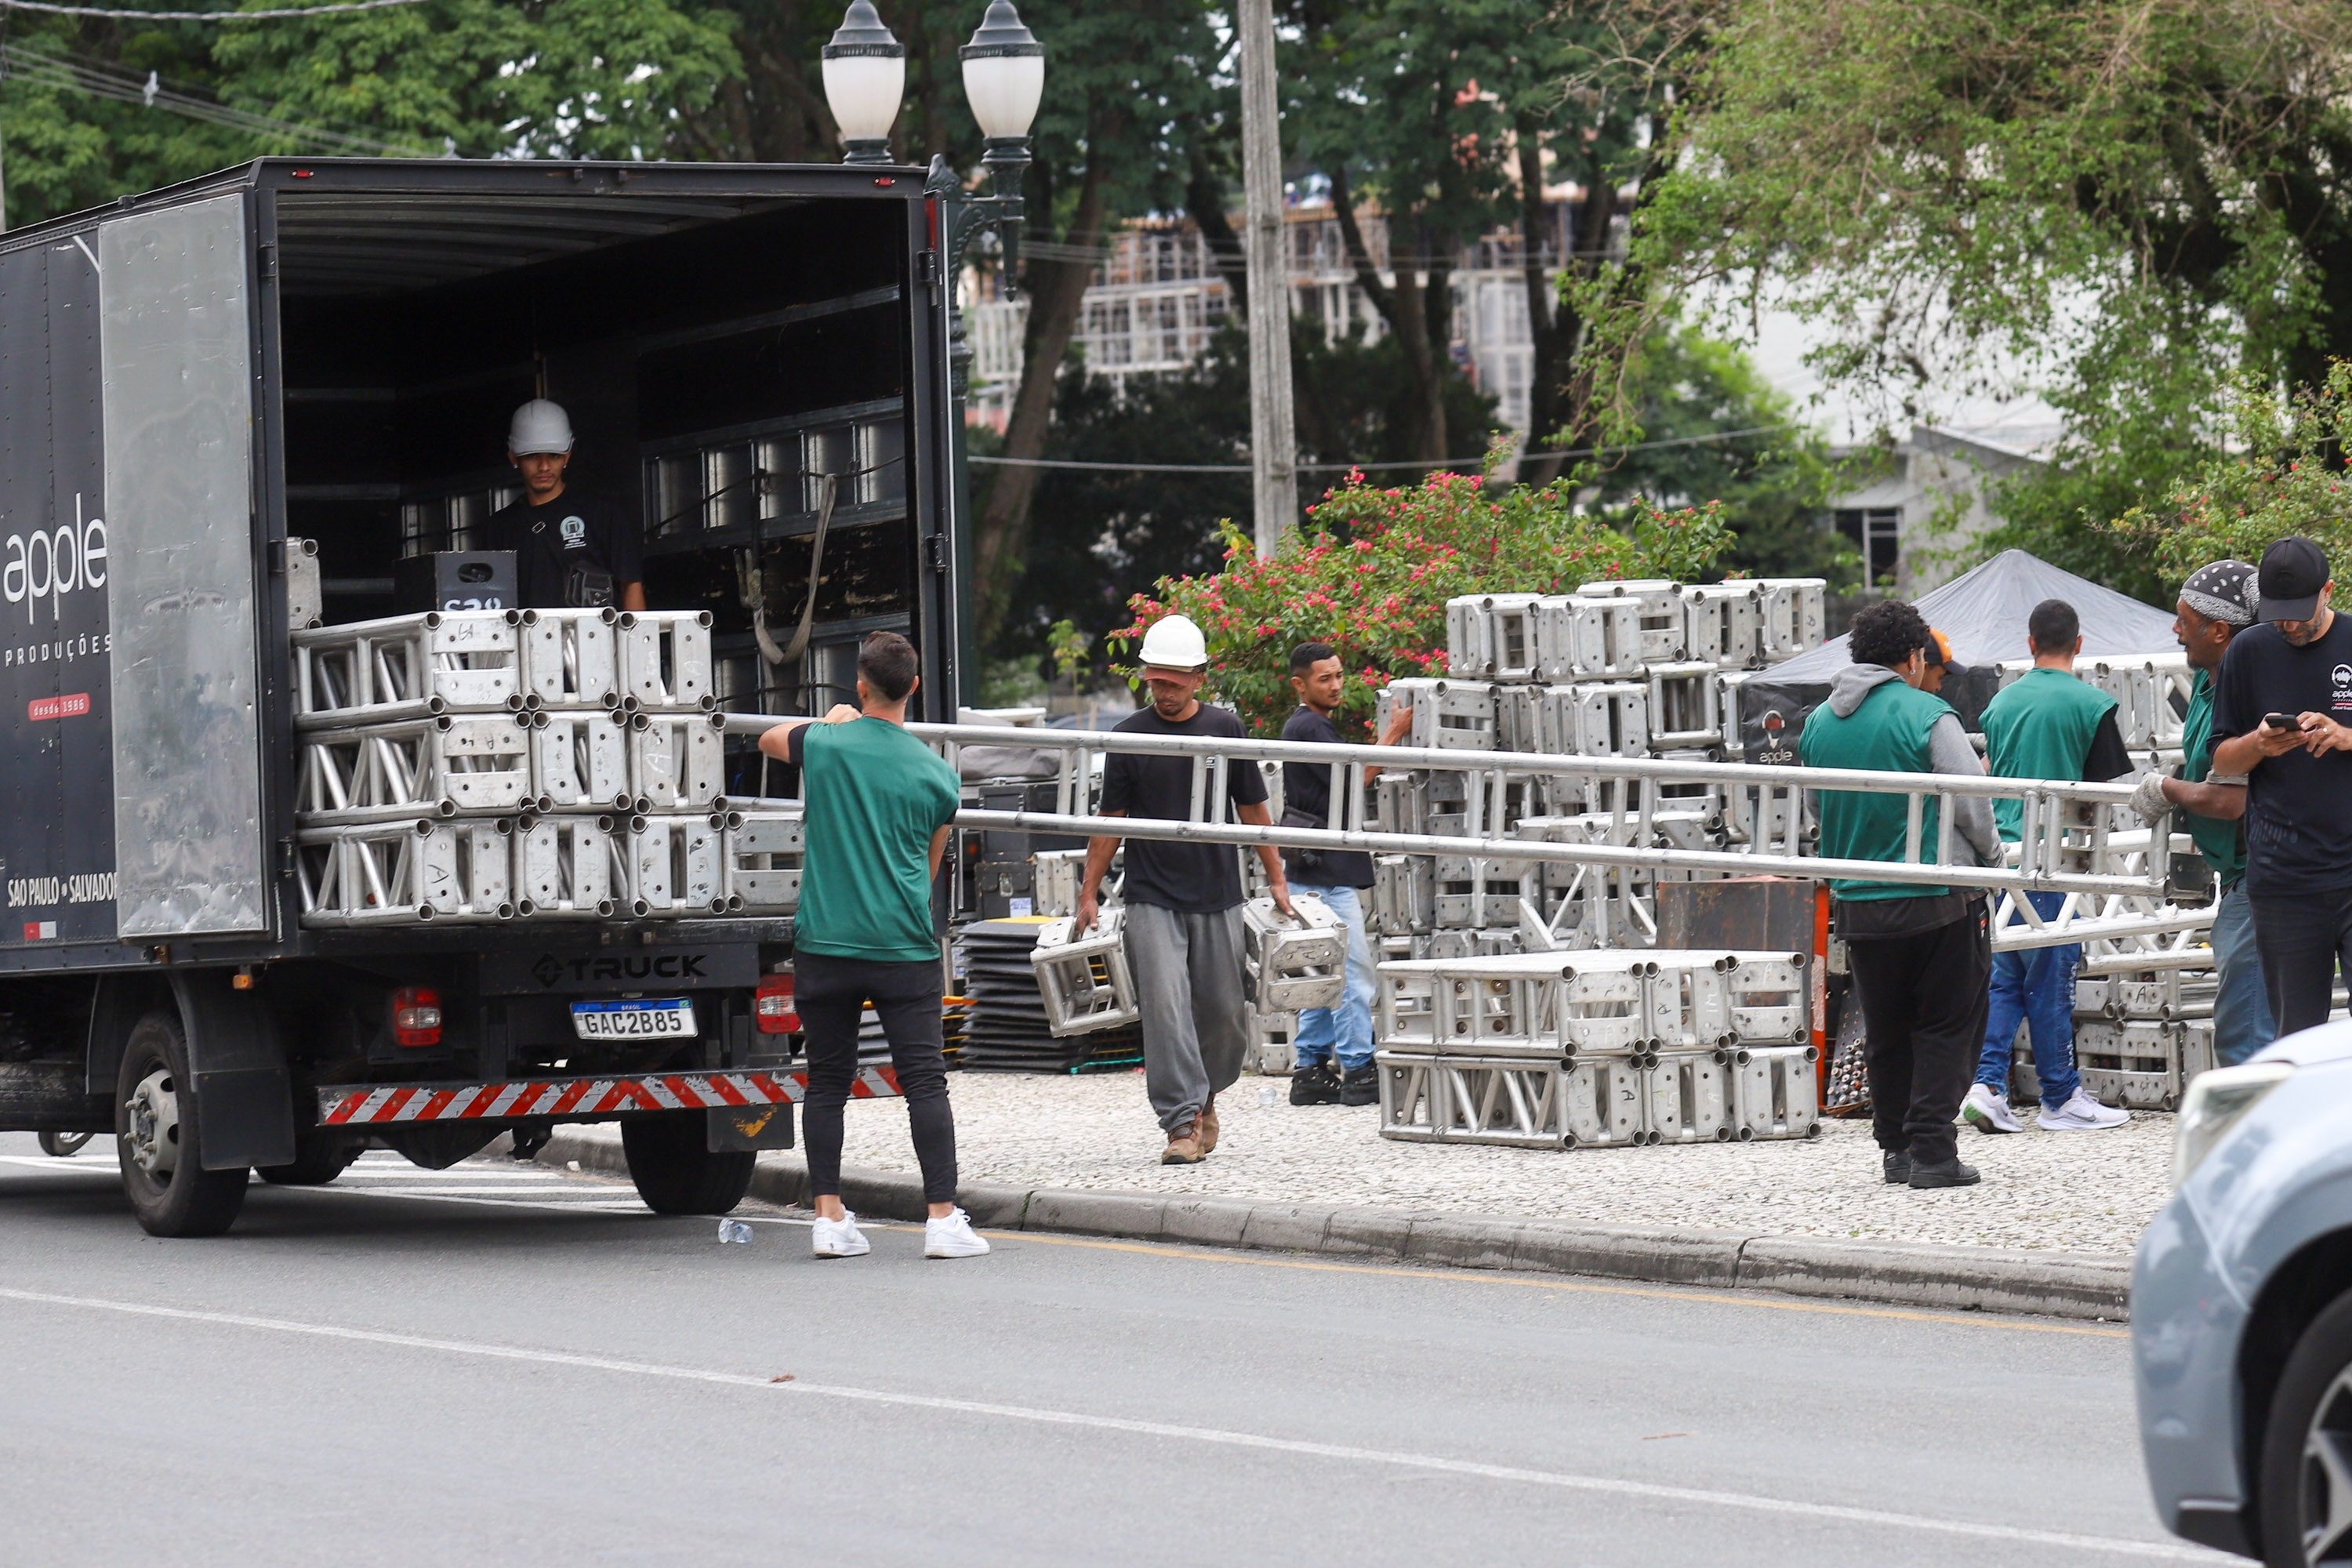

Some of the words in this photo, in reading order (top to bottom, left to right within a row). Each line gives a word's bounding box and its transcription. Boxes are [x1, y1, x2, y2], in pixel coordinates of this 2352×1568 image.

[3, 492, 107, 626] apple
[1759, 748, 1793, 764] apple
[28, 876, 60, 906] PAULO
[567, 954, 707, 982] TRUCK
[584, 1011, 681, 1035] GAC2B85
